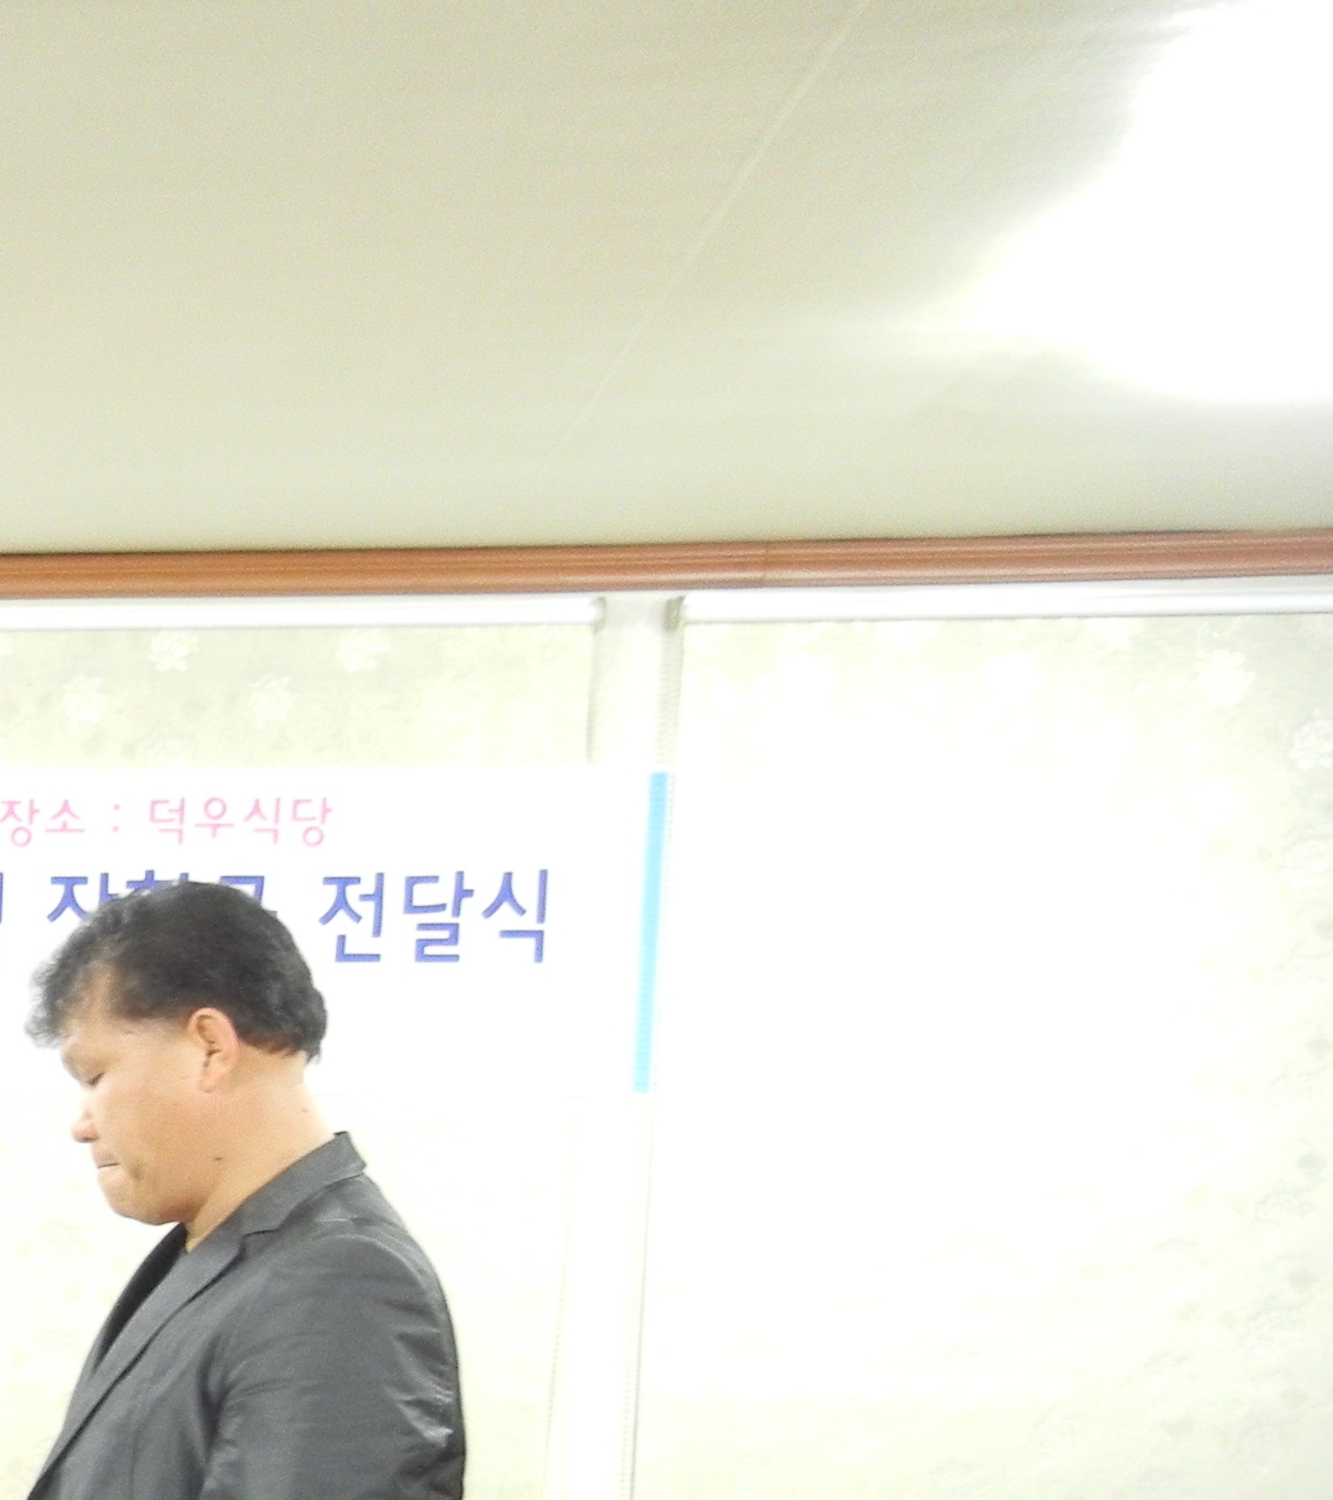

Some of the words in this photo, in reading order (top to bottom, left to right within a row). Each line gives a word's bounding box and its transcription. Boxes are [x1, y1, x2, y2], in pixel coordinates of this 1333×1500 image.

[0, 798, 85, 847] 장소
[148, 797, 333, 847] 덕우식당
[318, 869, 550, 964] 전달식
